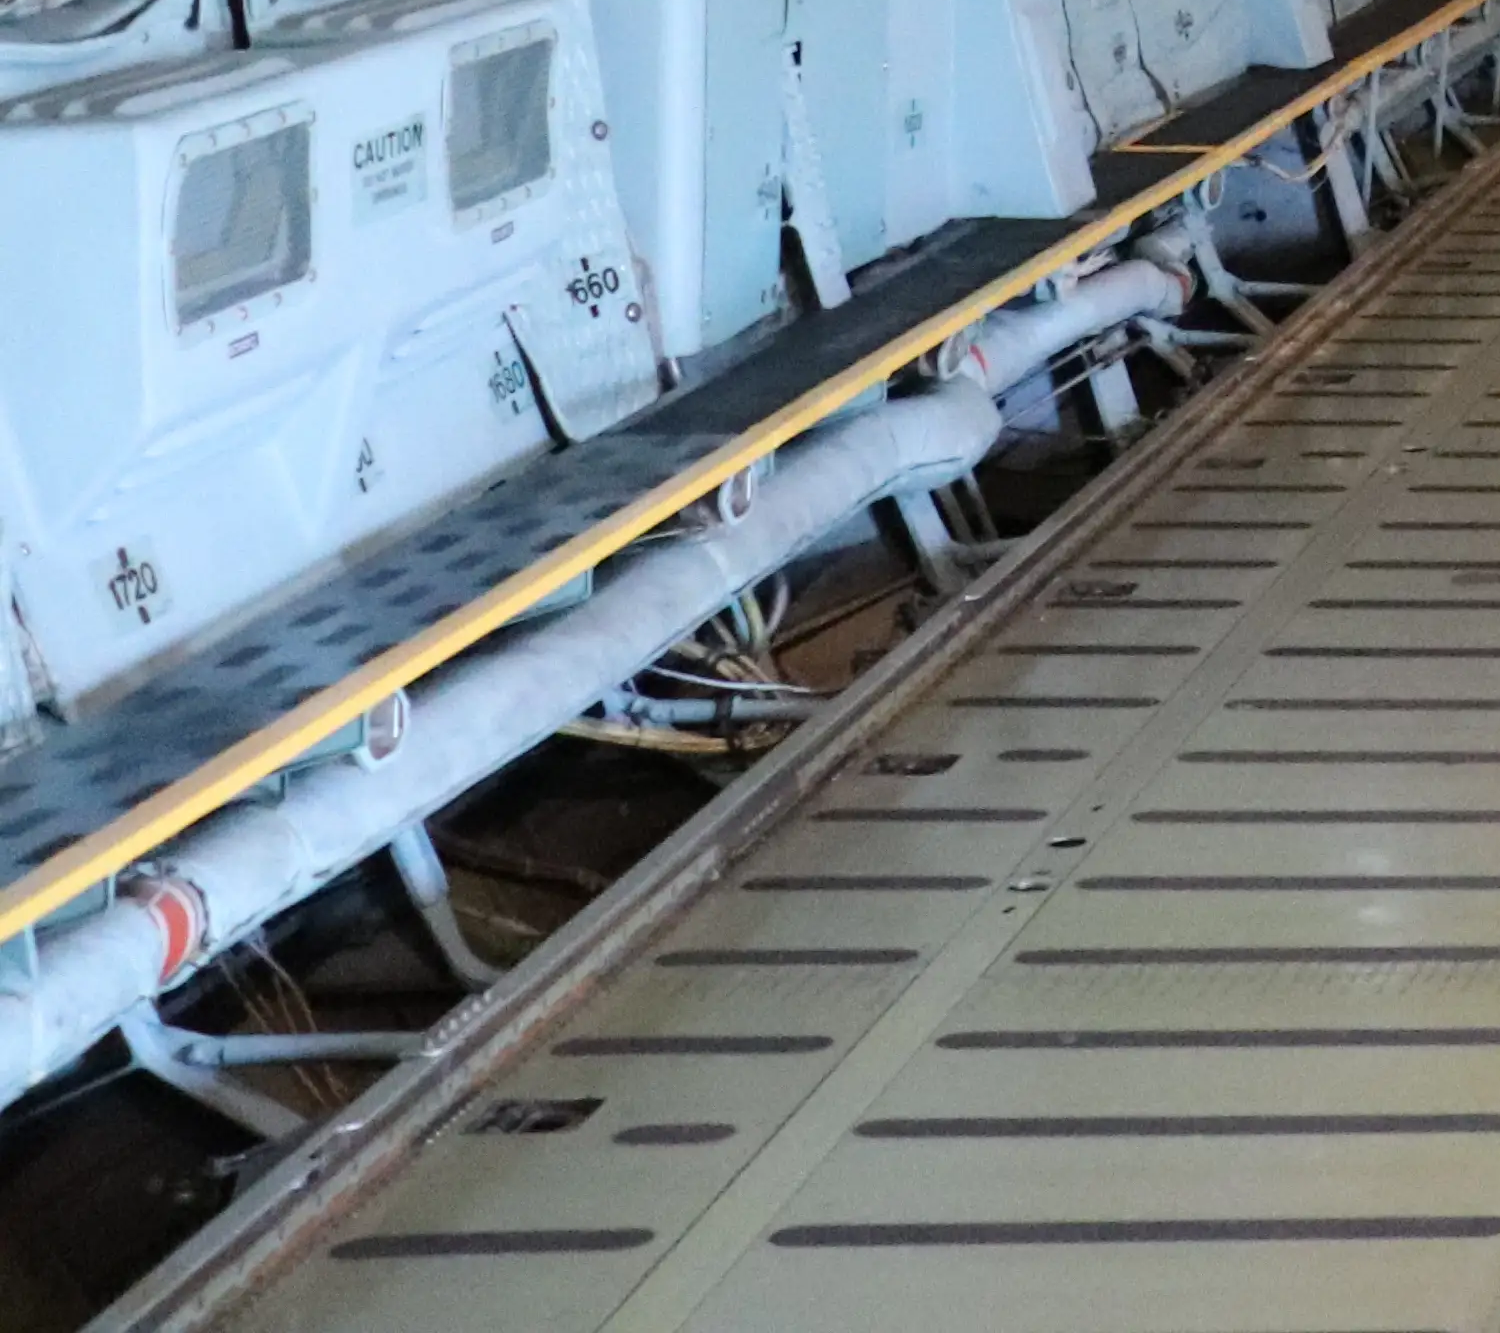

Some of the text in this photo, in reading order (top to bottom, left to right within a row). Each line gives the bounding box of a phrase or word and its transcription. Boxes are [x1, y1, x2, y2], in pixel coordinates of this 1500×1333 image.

[352, 120, 424, 170] CAUTION
[487, 359, 526, 404] 1680
[108, 561, 158, 611] 1720
